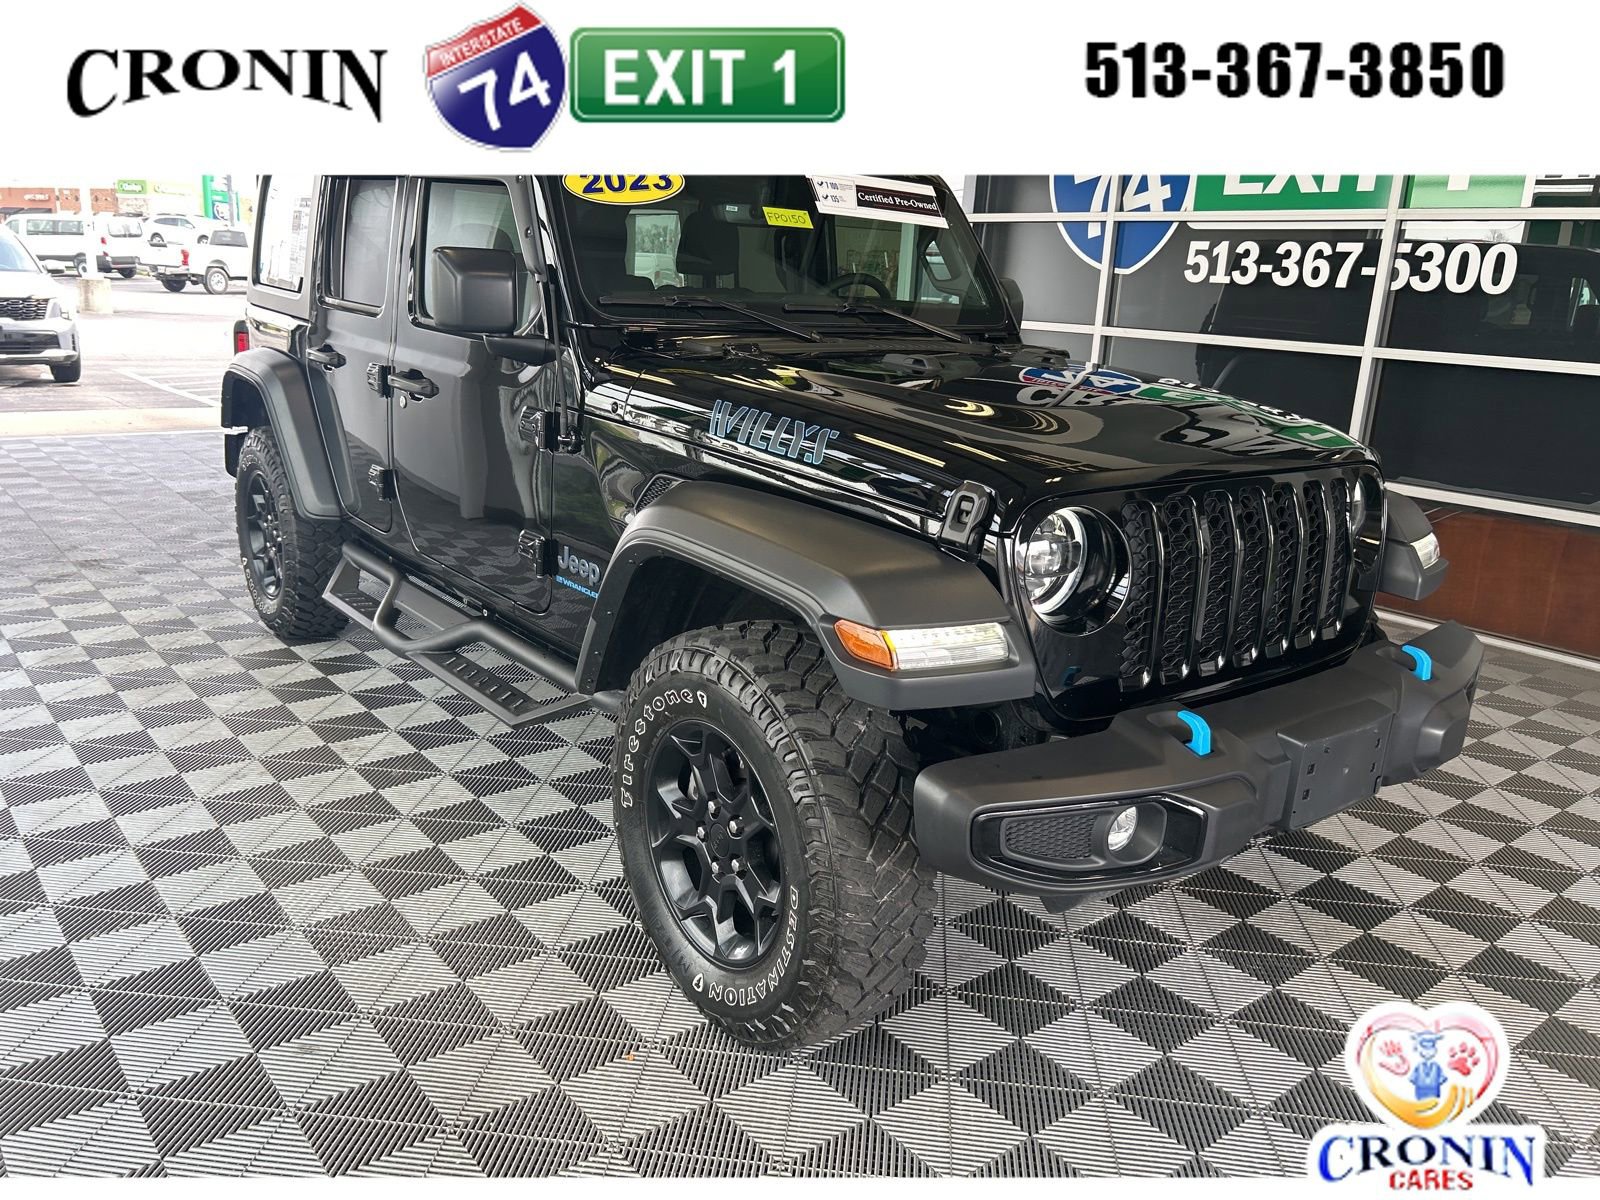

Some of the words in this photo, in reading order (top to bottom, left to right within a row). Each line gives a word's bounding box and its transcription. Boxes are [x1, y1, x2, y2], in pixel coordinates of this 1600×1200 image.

[857, 191, 894, 205] Certified
[895, 196, 938, 211] Pre-Owned
[708, 399, 841, 465] WILLYS
[557, 545, 601, 586] Jeep
[620, 688, 694, 809] Firestone
[708, 885, 799, 1007] DESTINATION
